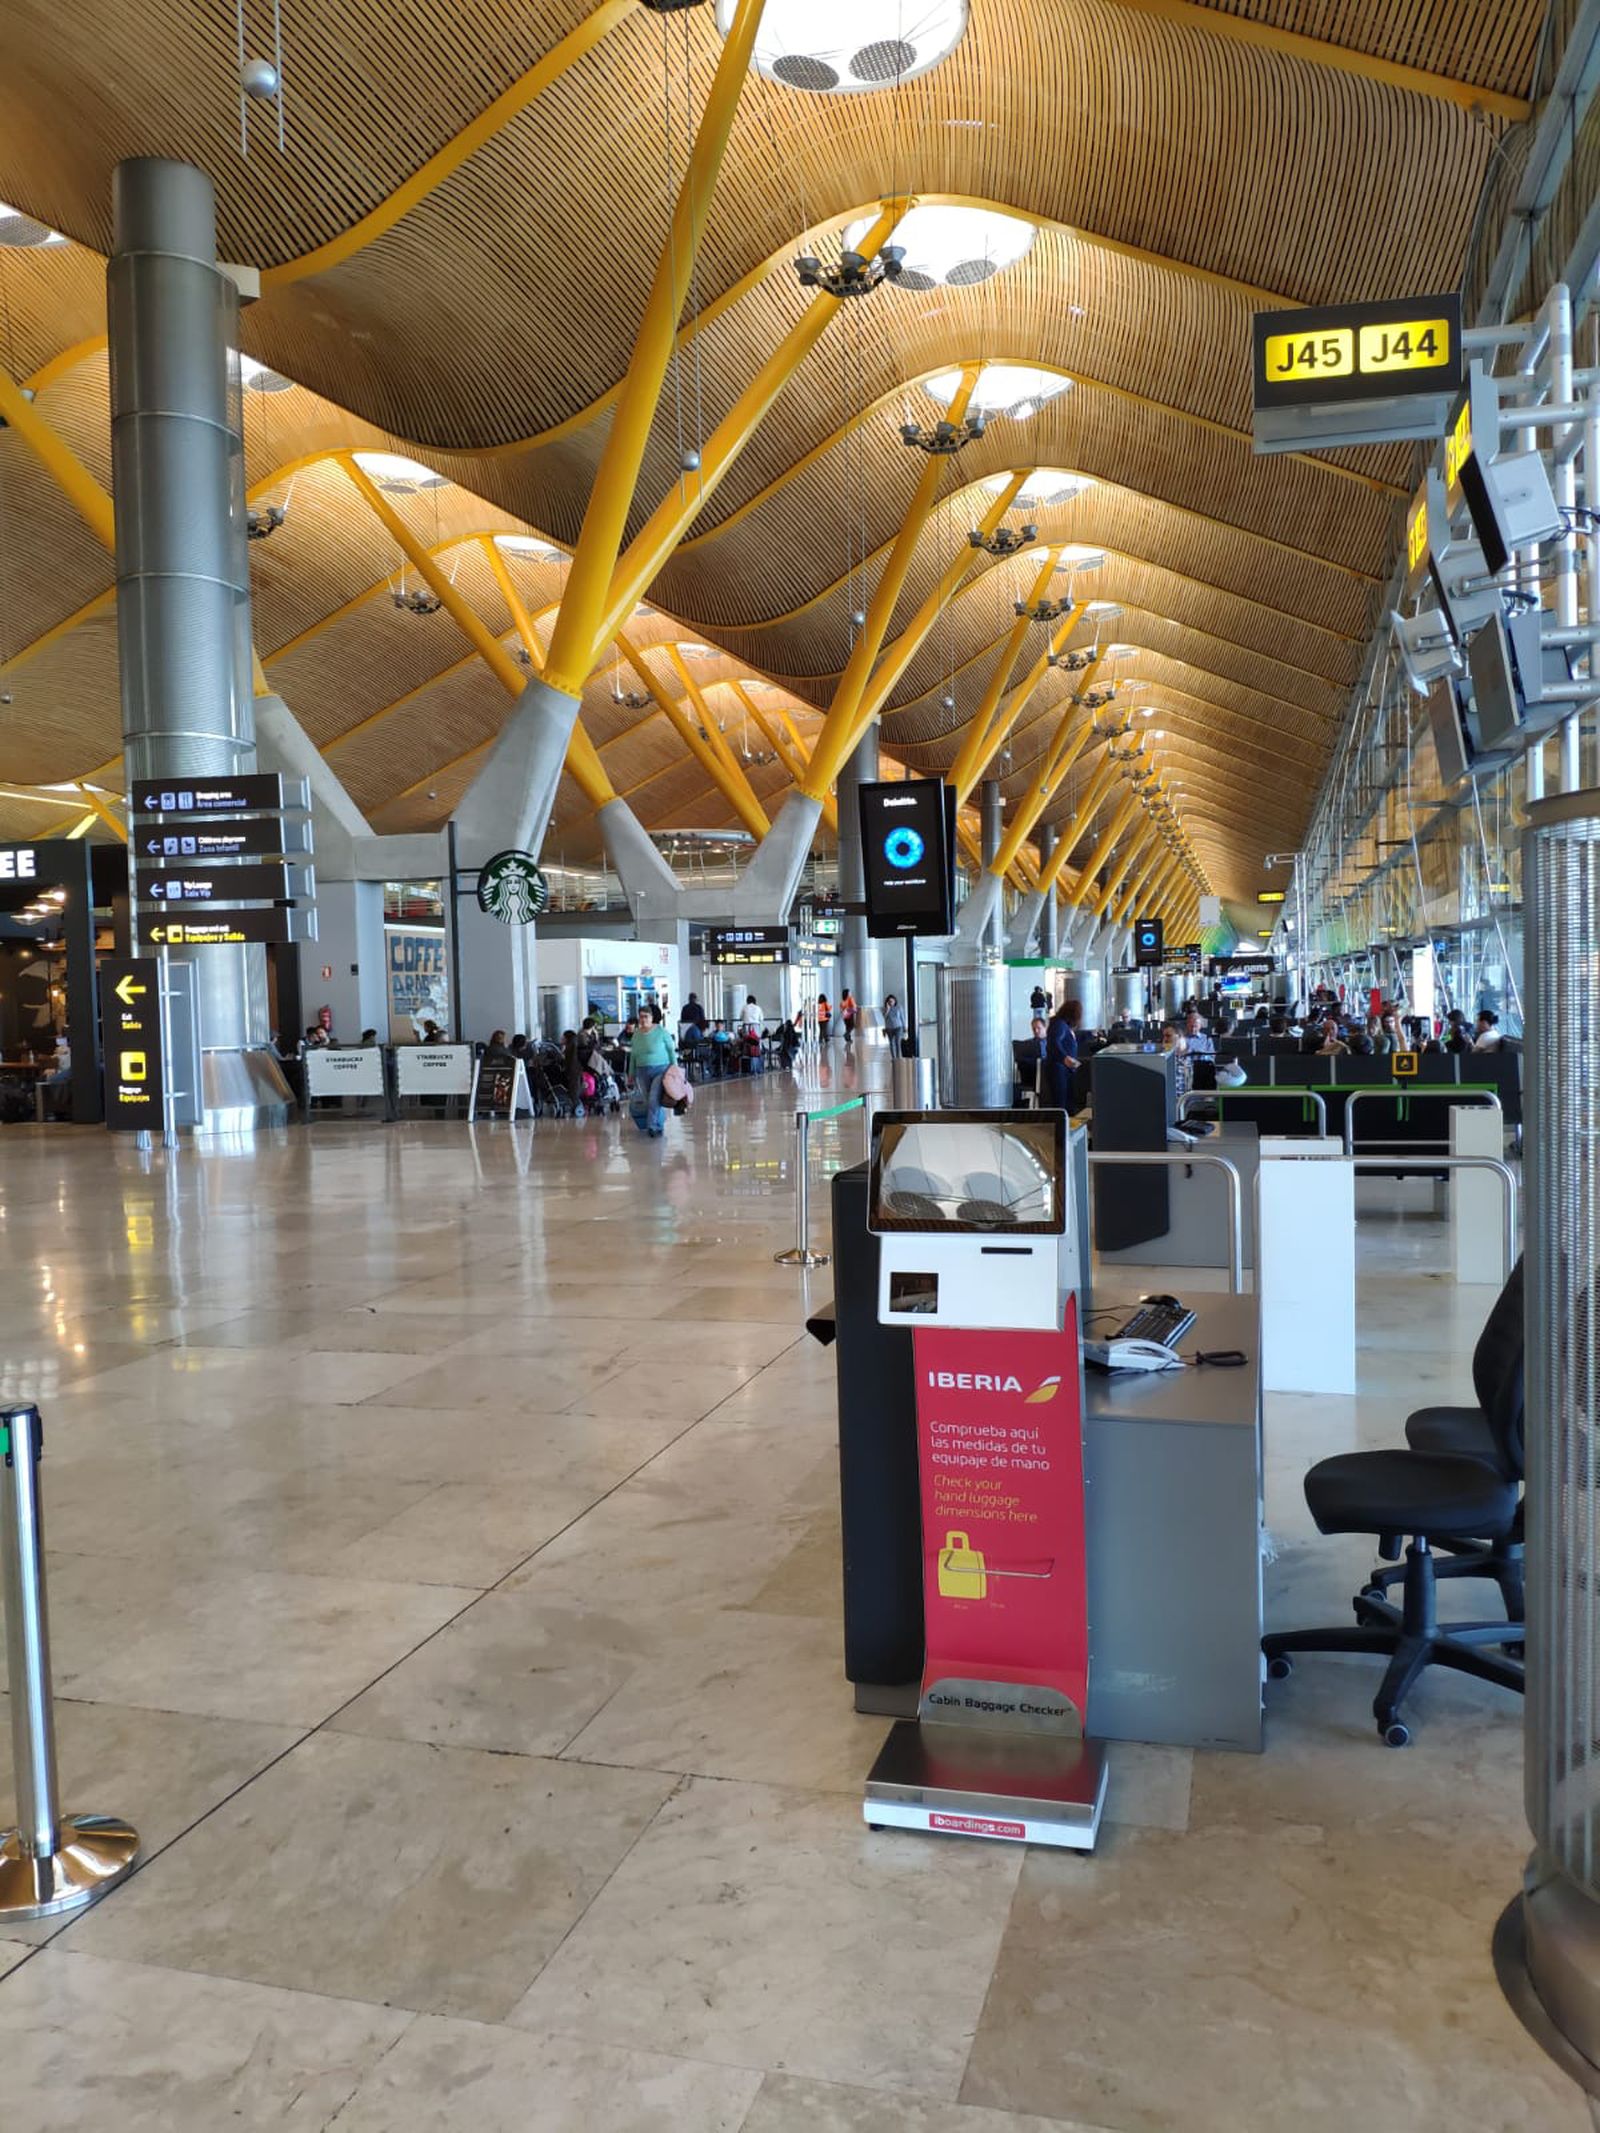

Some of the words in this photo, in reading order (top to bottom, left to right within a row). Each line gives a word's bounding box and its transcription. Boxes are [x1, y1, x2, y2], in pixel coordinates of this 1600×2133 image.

[1276, 338, 1342, 373] J45
[1371, 328, 1438, 363] J44
[928, 1371, 1023, 1393] IBERIA
[929, 1420, 1007, 1438] Comprueba
[931, 1436, 949, 1449] las
[952, 1439, 1008, 1453] medidas
[1011, 1442, 1028, 1454] de
[1032, 1443, 1046, 1455] tu
[931, 1453, 988, 1469] equipaje
[991, 1455, 1008, 1468] de
[1011, 1459, 1050, 1471] mano
[934, 1474, 972, 1488] Check
[975, 1480, 1002, 1492] your
[934, 1490, 966, 1503] hand
[969, 1493, 1020, 1509] luggage
[935, 1503, 1006, 1521] dimensions
[1008, 1509, 1038, 1523] here
[928, 1693, 961, 1707] Cabin
[965, 1698, 1016, 1714] Baggage
